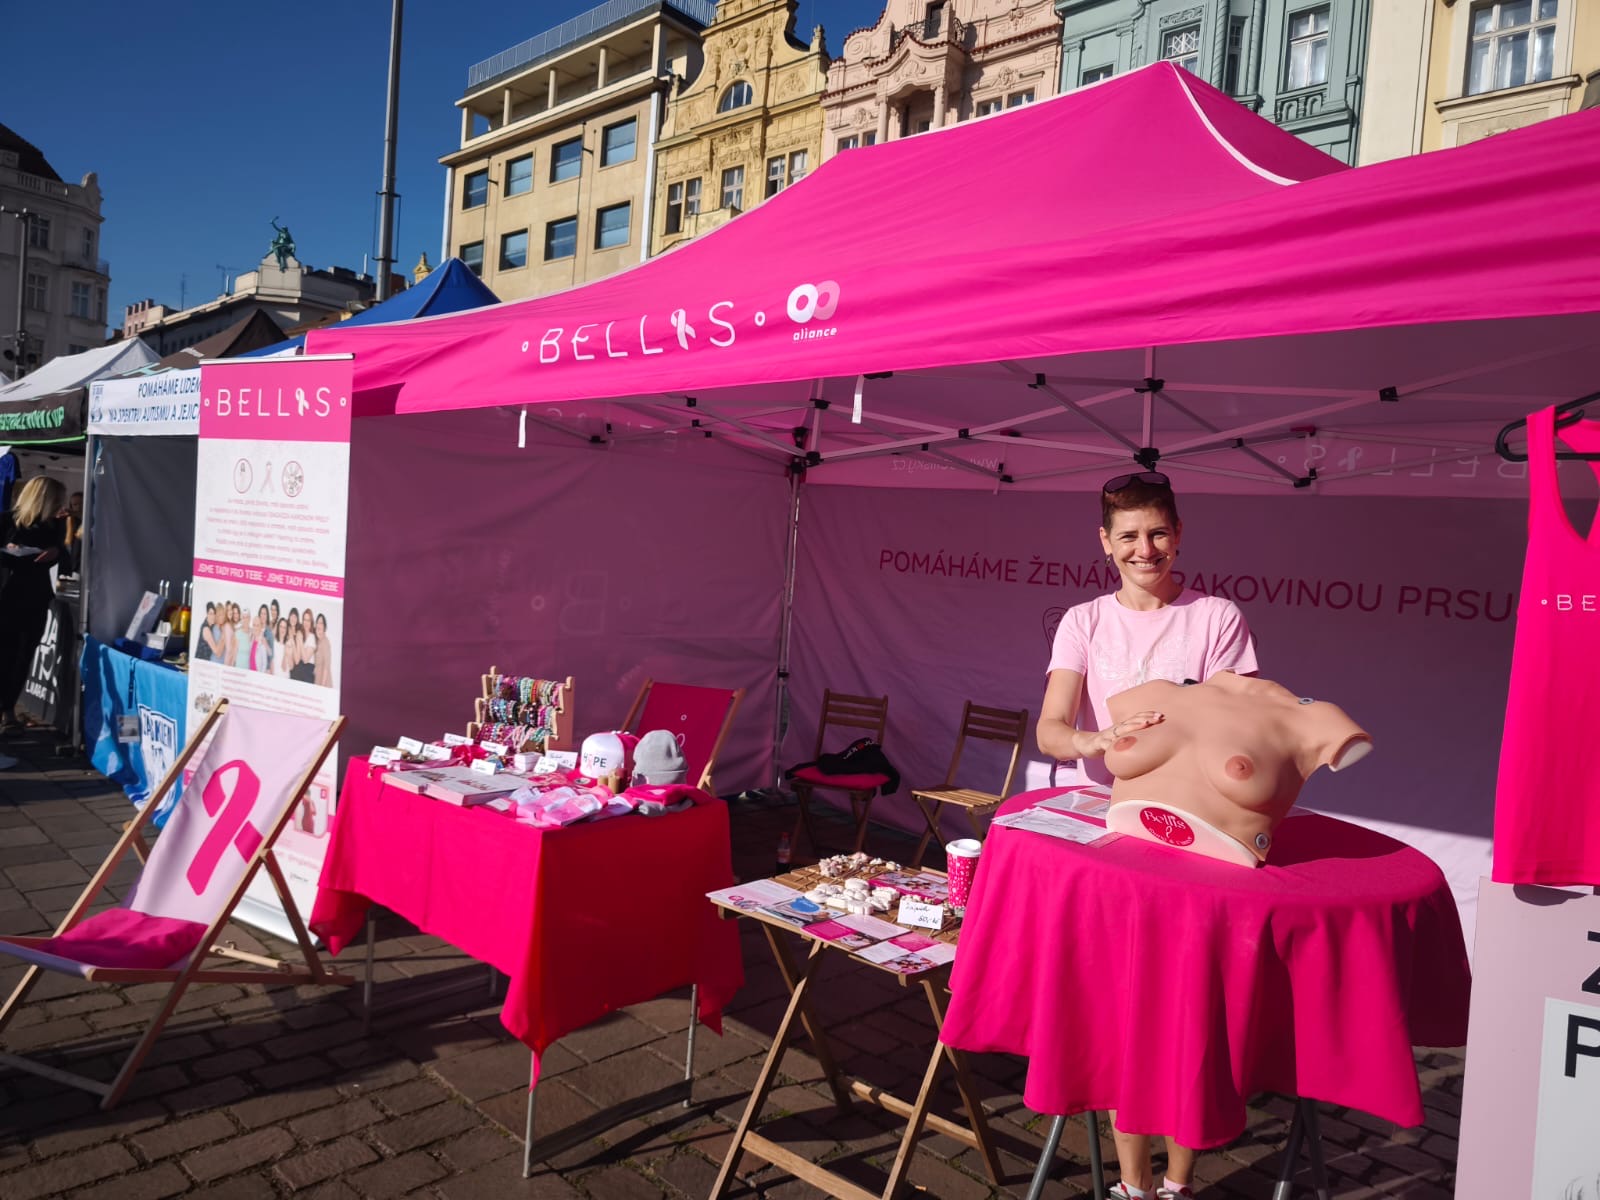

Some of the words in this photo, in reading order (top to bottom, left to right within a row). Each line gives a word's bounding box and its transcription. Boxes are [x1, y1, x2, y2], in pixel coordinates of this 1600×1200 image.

[793, 327, 838, 341] aliance
[198, 563, 214, 574] JSME
[215, 565, 229, 576] TADY
[230, 567, 244, 578] PRO
[245, 569, 264, 581] TEBE
[266, 573, 286, 585] JSME
[286, 575, 304, 587] TADY
[304, 577, 319, 589] PRO
[319, 580, 339, 592] SEBE
[879, 548, 1019, 583] POMÁHÁME
[1397, 585, 1513, 622] PRSU
